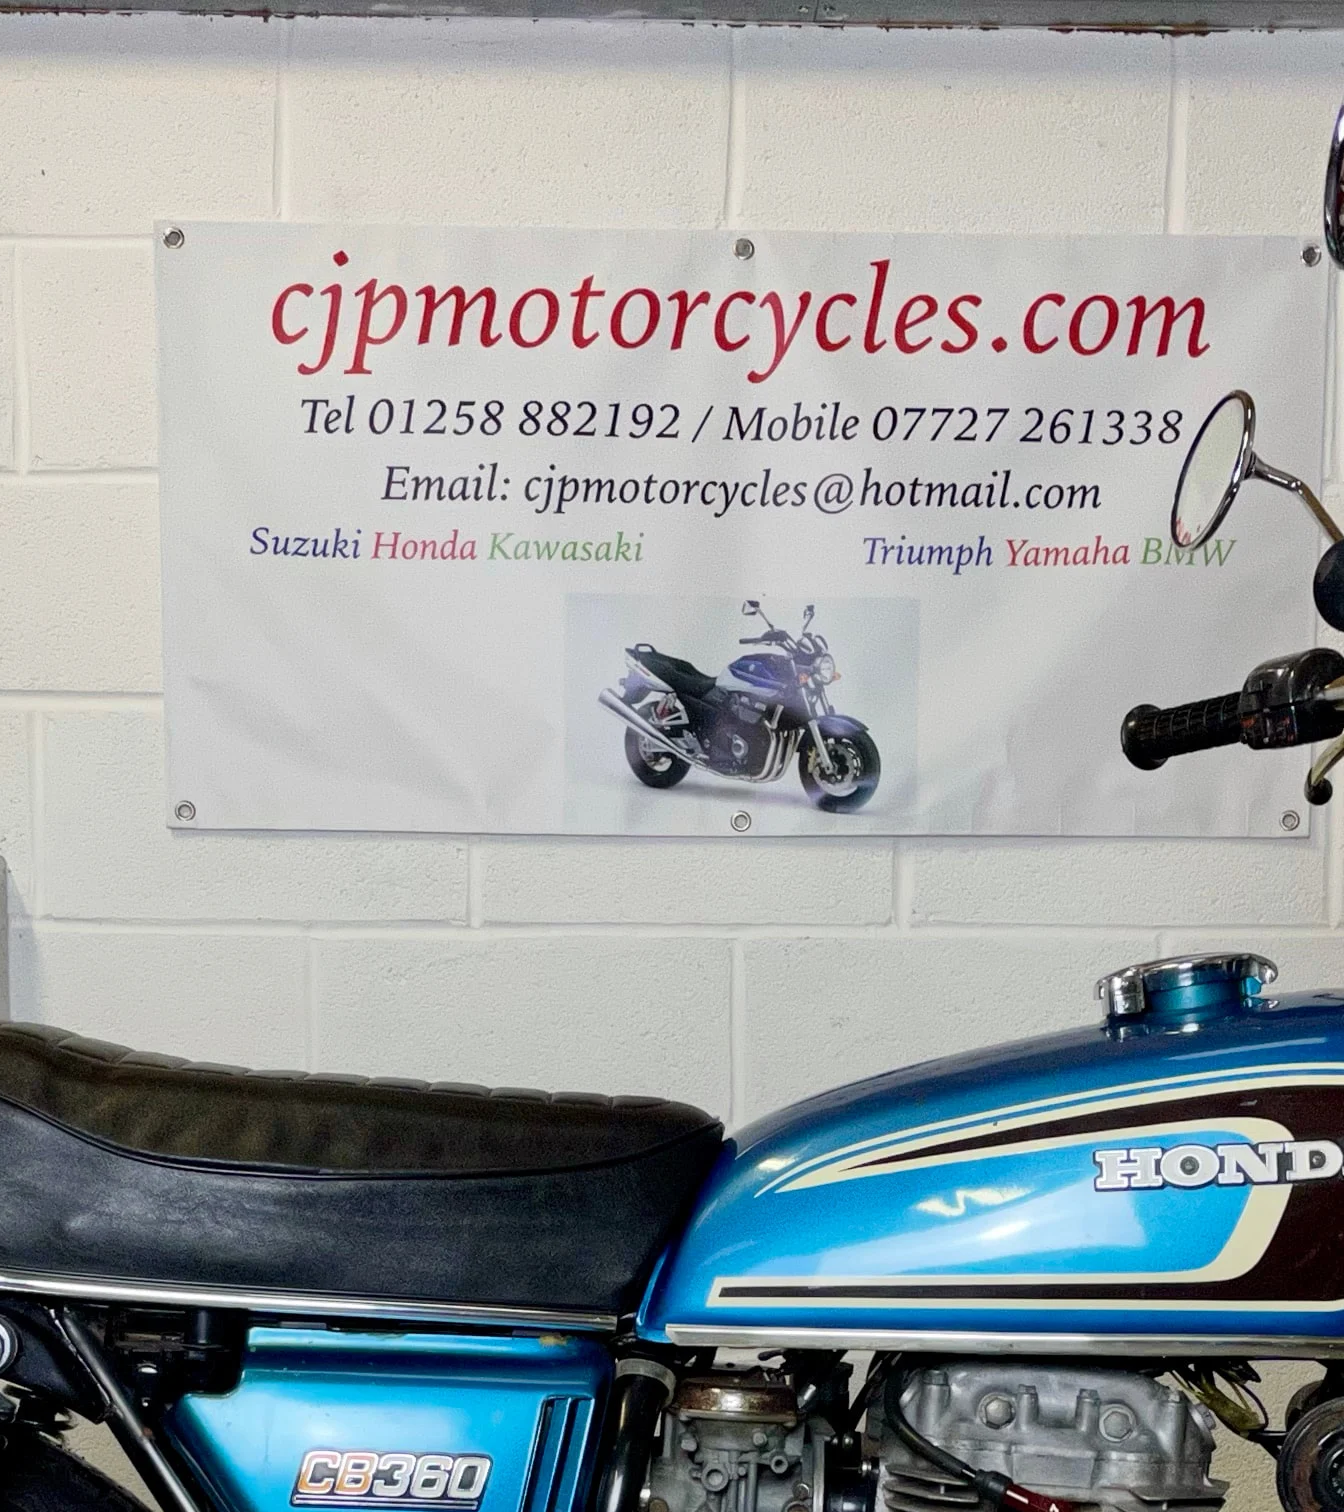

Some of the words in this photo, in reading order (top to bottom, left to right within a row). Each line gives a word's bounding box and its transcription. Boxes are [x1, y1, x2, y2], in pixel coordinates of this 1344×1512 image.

[271, 250, 1211, 384] cjpmotorcycles.com
[300, 394, 356, 436] Tel
[368, 398, 505, 437] 01258
[518, 399, 682, 440] 882192
[691, 404, 715, 444] /
[721, 401, 860, 442] Mobile
[872, 405, 1011, 443] 07727
[1018, 406, 1184, 446] 261338
[380, 461, 511, 502] Email:
[523, 463, 1102, 519] cjpmotorcycles@hotmail.com
[249, 526, 361, 560] Suzuki
[370, 528, 478, 561] Honda
[487, 531, 644, 562] Kawasaki
[862, 534, 994, 576] Triumph
[1005, 534, 1131, 567] Yamaha
[296, 1450, 492, 1500] CB360
